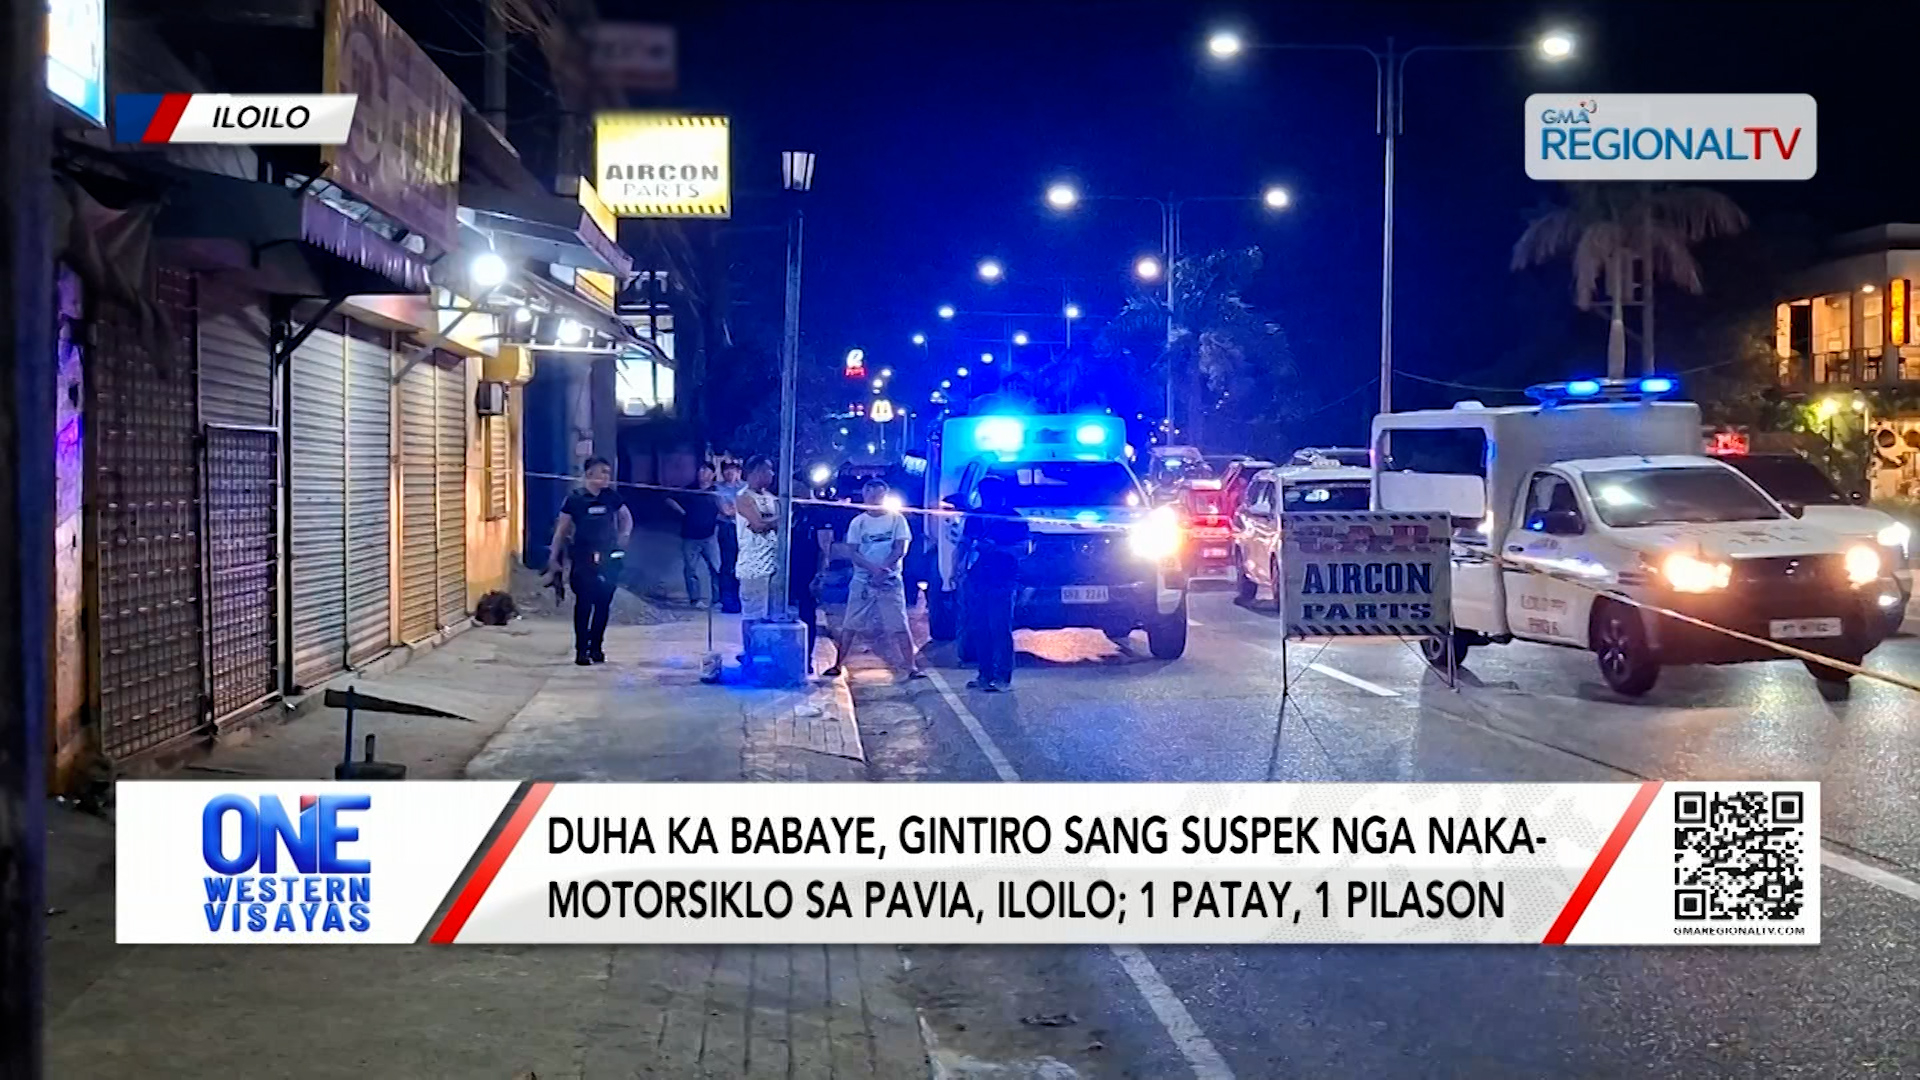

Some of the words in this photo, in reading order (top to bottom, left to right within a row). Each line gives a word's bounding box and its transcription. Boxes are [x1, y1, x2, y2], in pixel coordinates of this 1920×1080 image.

[605, 164, 719, 182] AIRCON
[623, 183, 700, 199] PARTS
[1301, 562, 1432, 595] AIRCON
[1301, 602, 1432, 621] PARTS
